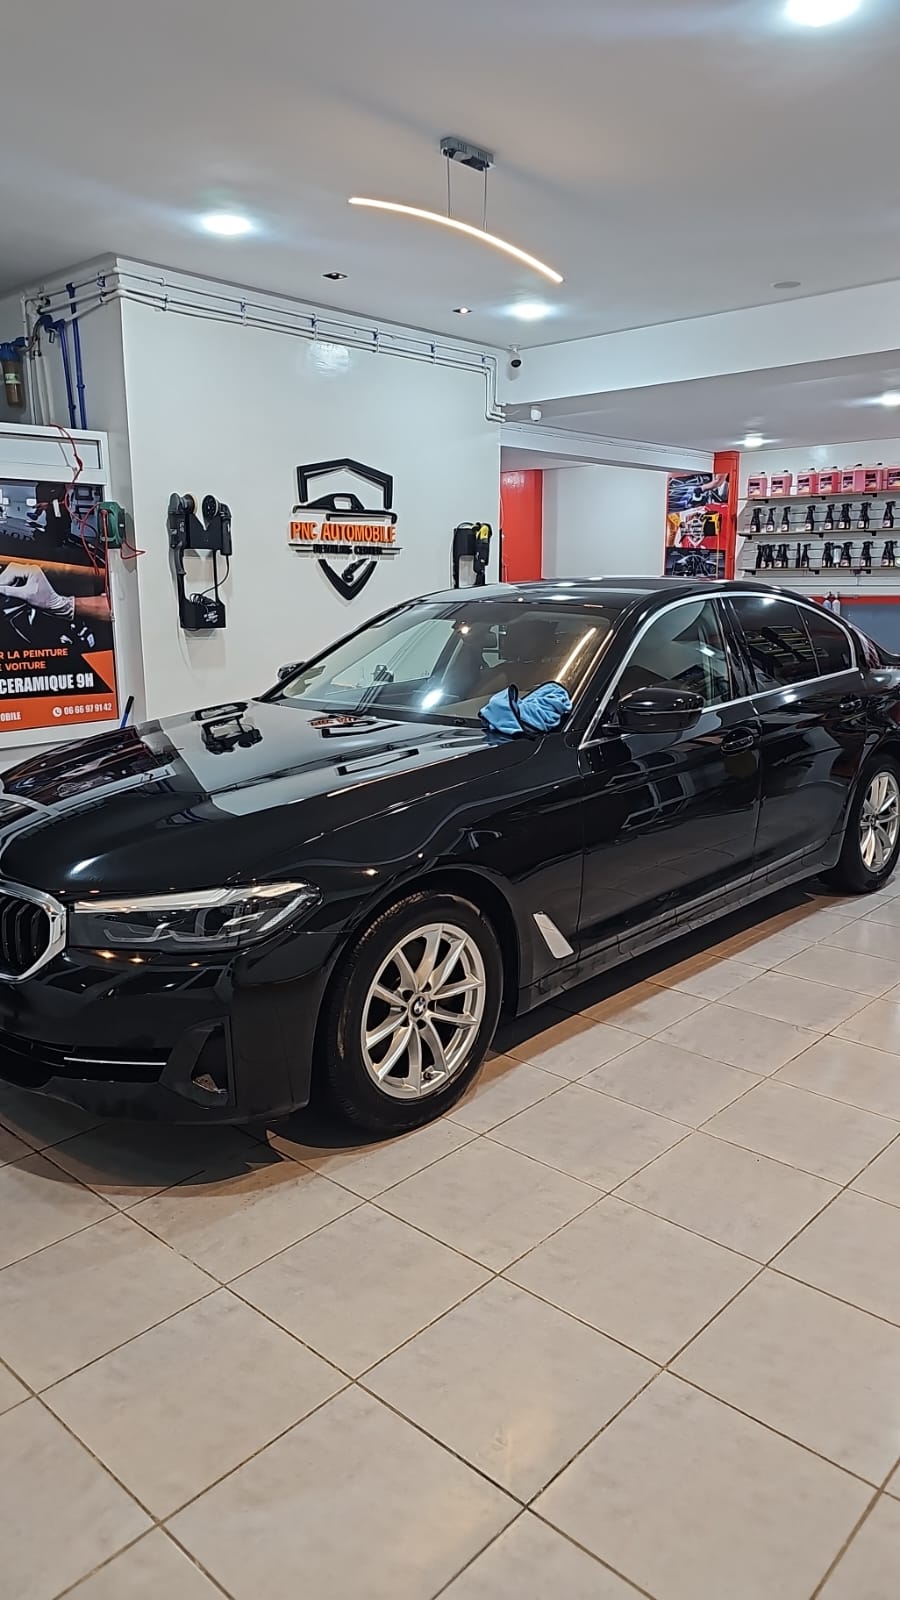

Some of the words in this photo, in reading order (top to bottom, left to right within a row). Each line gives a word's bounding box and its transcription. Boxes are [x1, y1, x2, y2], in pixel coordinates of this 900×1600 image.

[290, 521, 318, 540] PNC
[321, 523, 396, 543] AUTOMOBILE
[7, 651, 20, 659] LA
[23, 648, 68, 658] PEINTURE
[5, 661, 46, 671] VOITURE
[0, 674, 74, 694] CERAMIQUE
[76, 673, 94, 688] 9H
